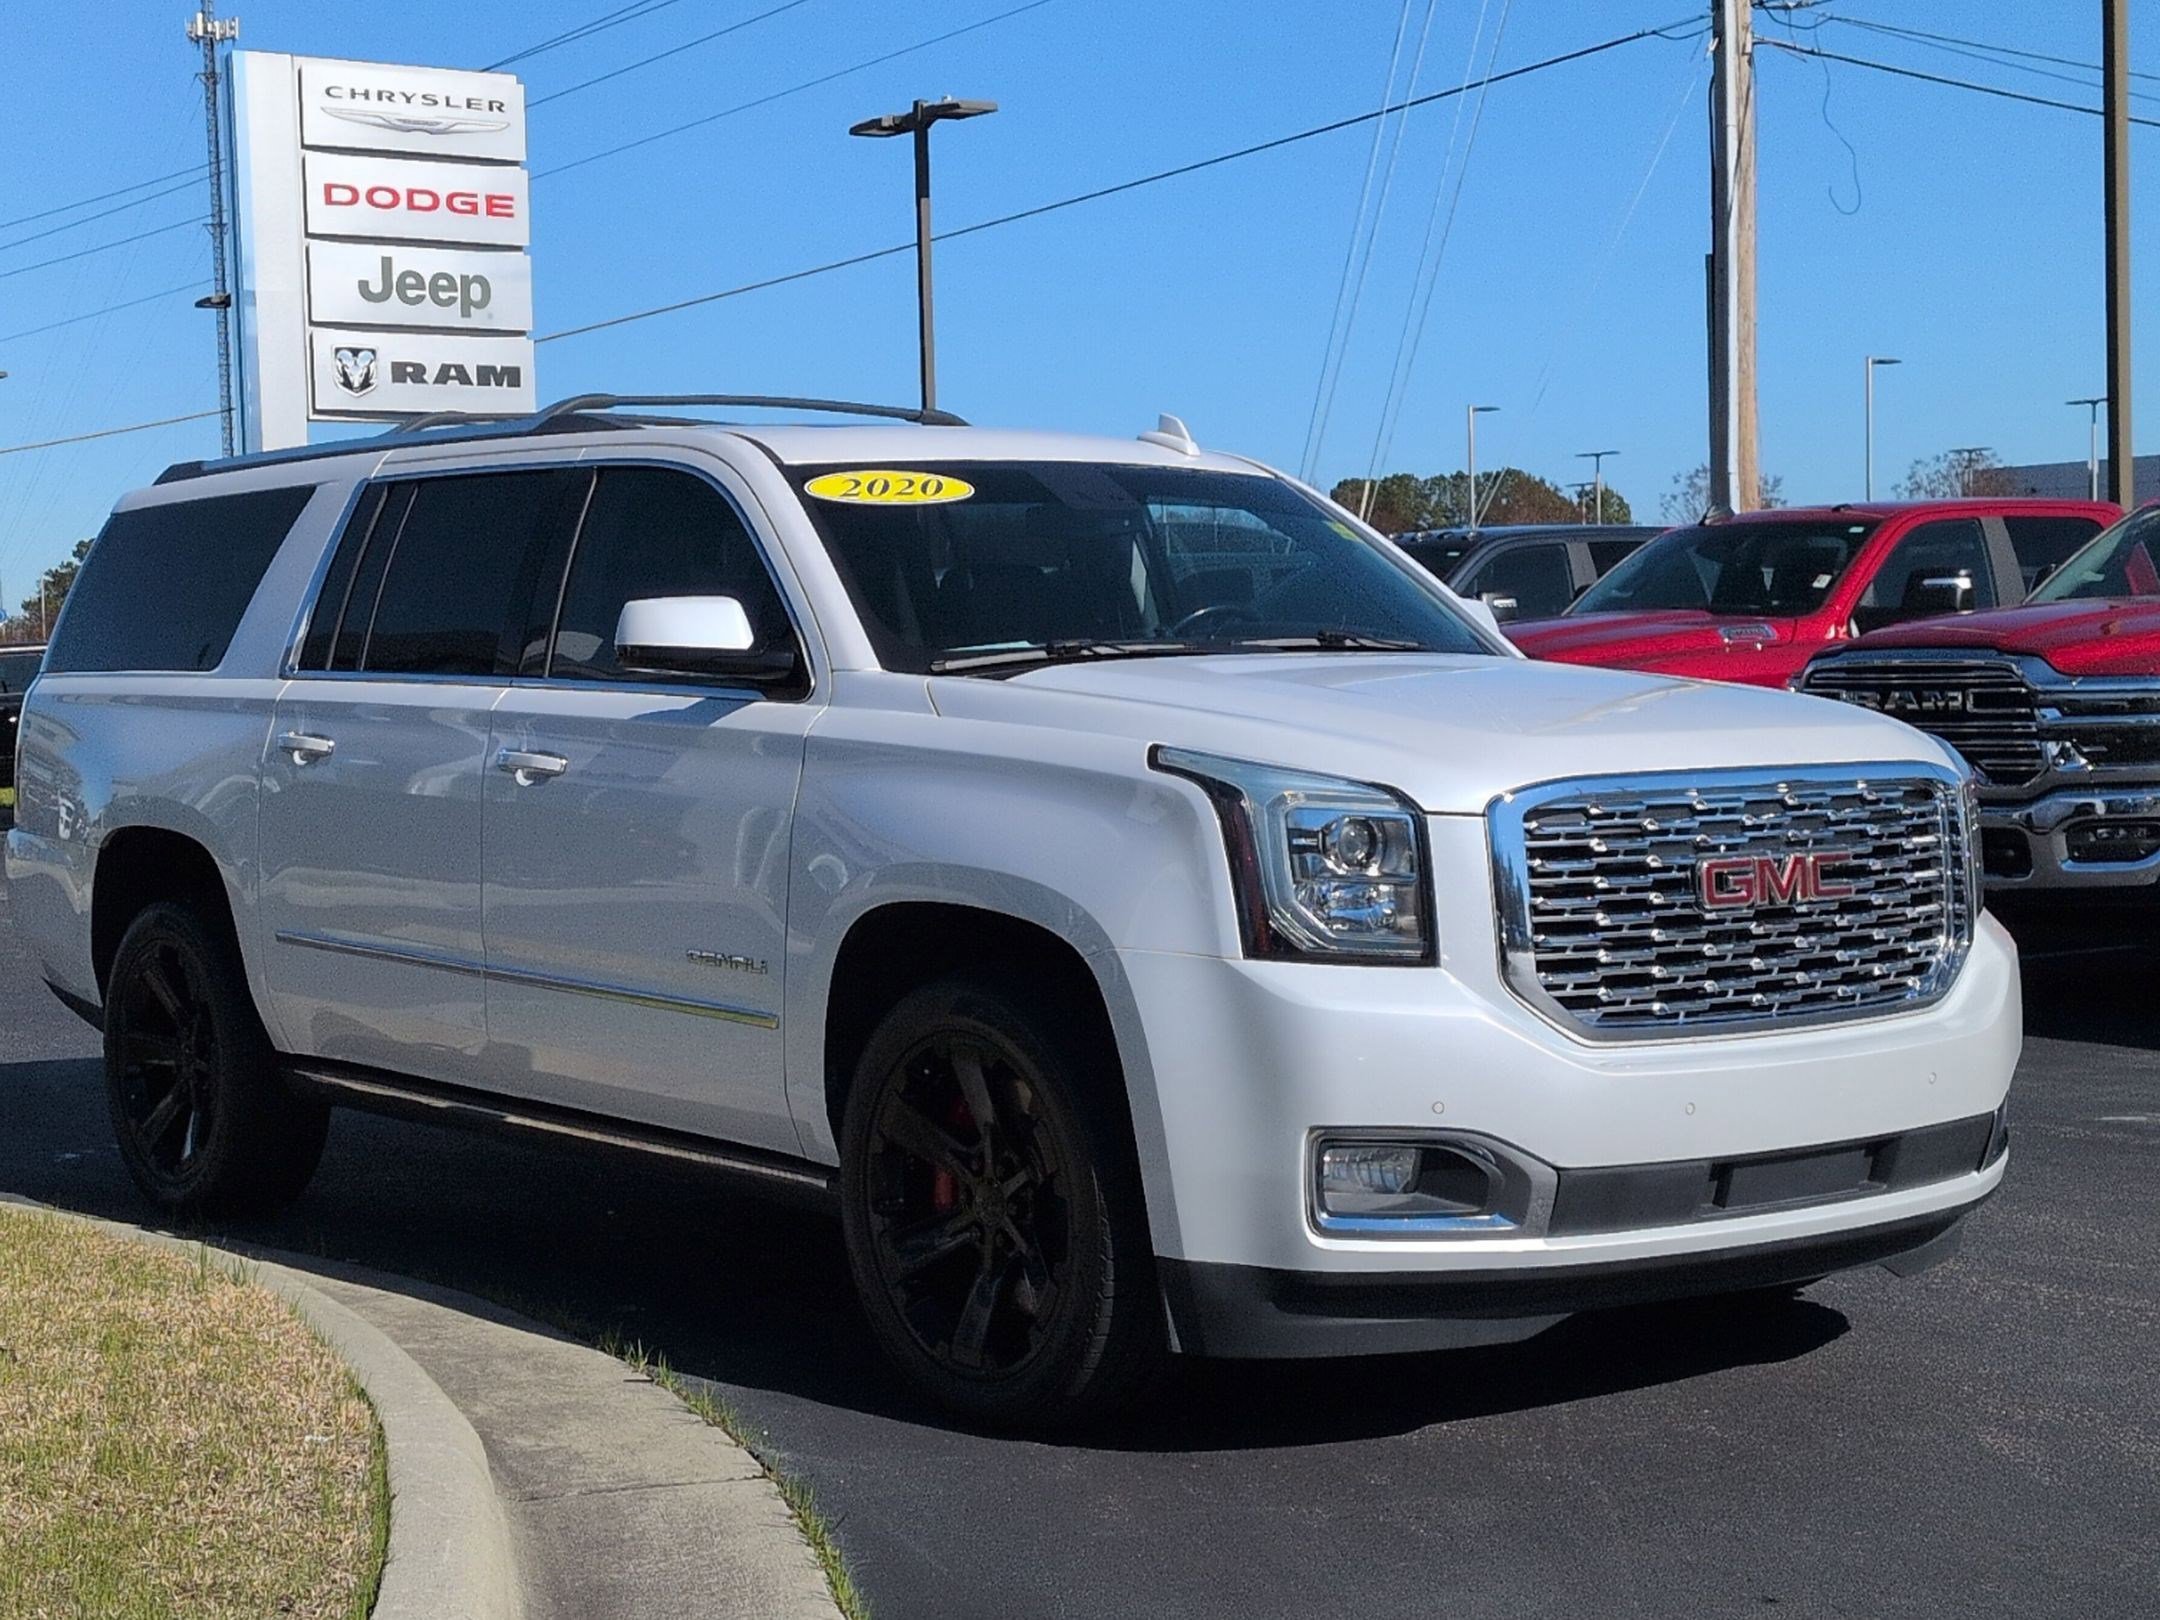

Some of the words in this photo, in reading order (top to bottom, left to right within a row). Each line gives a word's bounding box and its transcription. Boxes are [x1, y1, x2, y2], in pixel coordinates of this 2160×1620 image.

[325, 86, 505, 113] CHRYSLER
[324, 183, 514, 217] DODGE
[358, 256, 491, 318] Jeep
[391, 361, 521, 388] RAM
[839, 478, 944, 497] 2020
[1703, 852, 1854, 908] GMC
